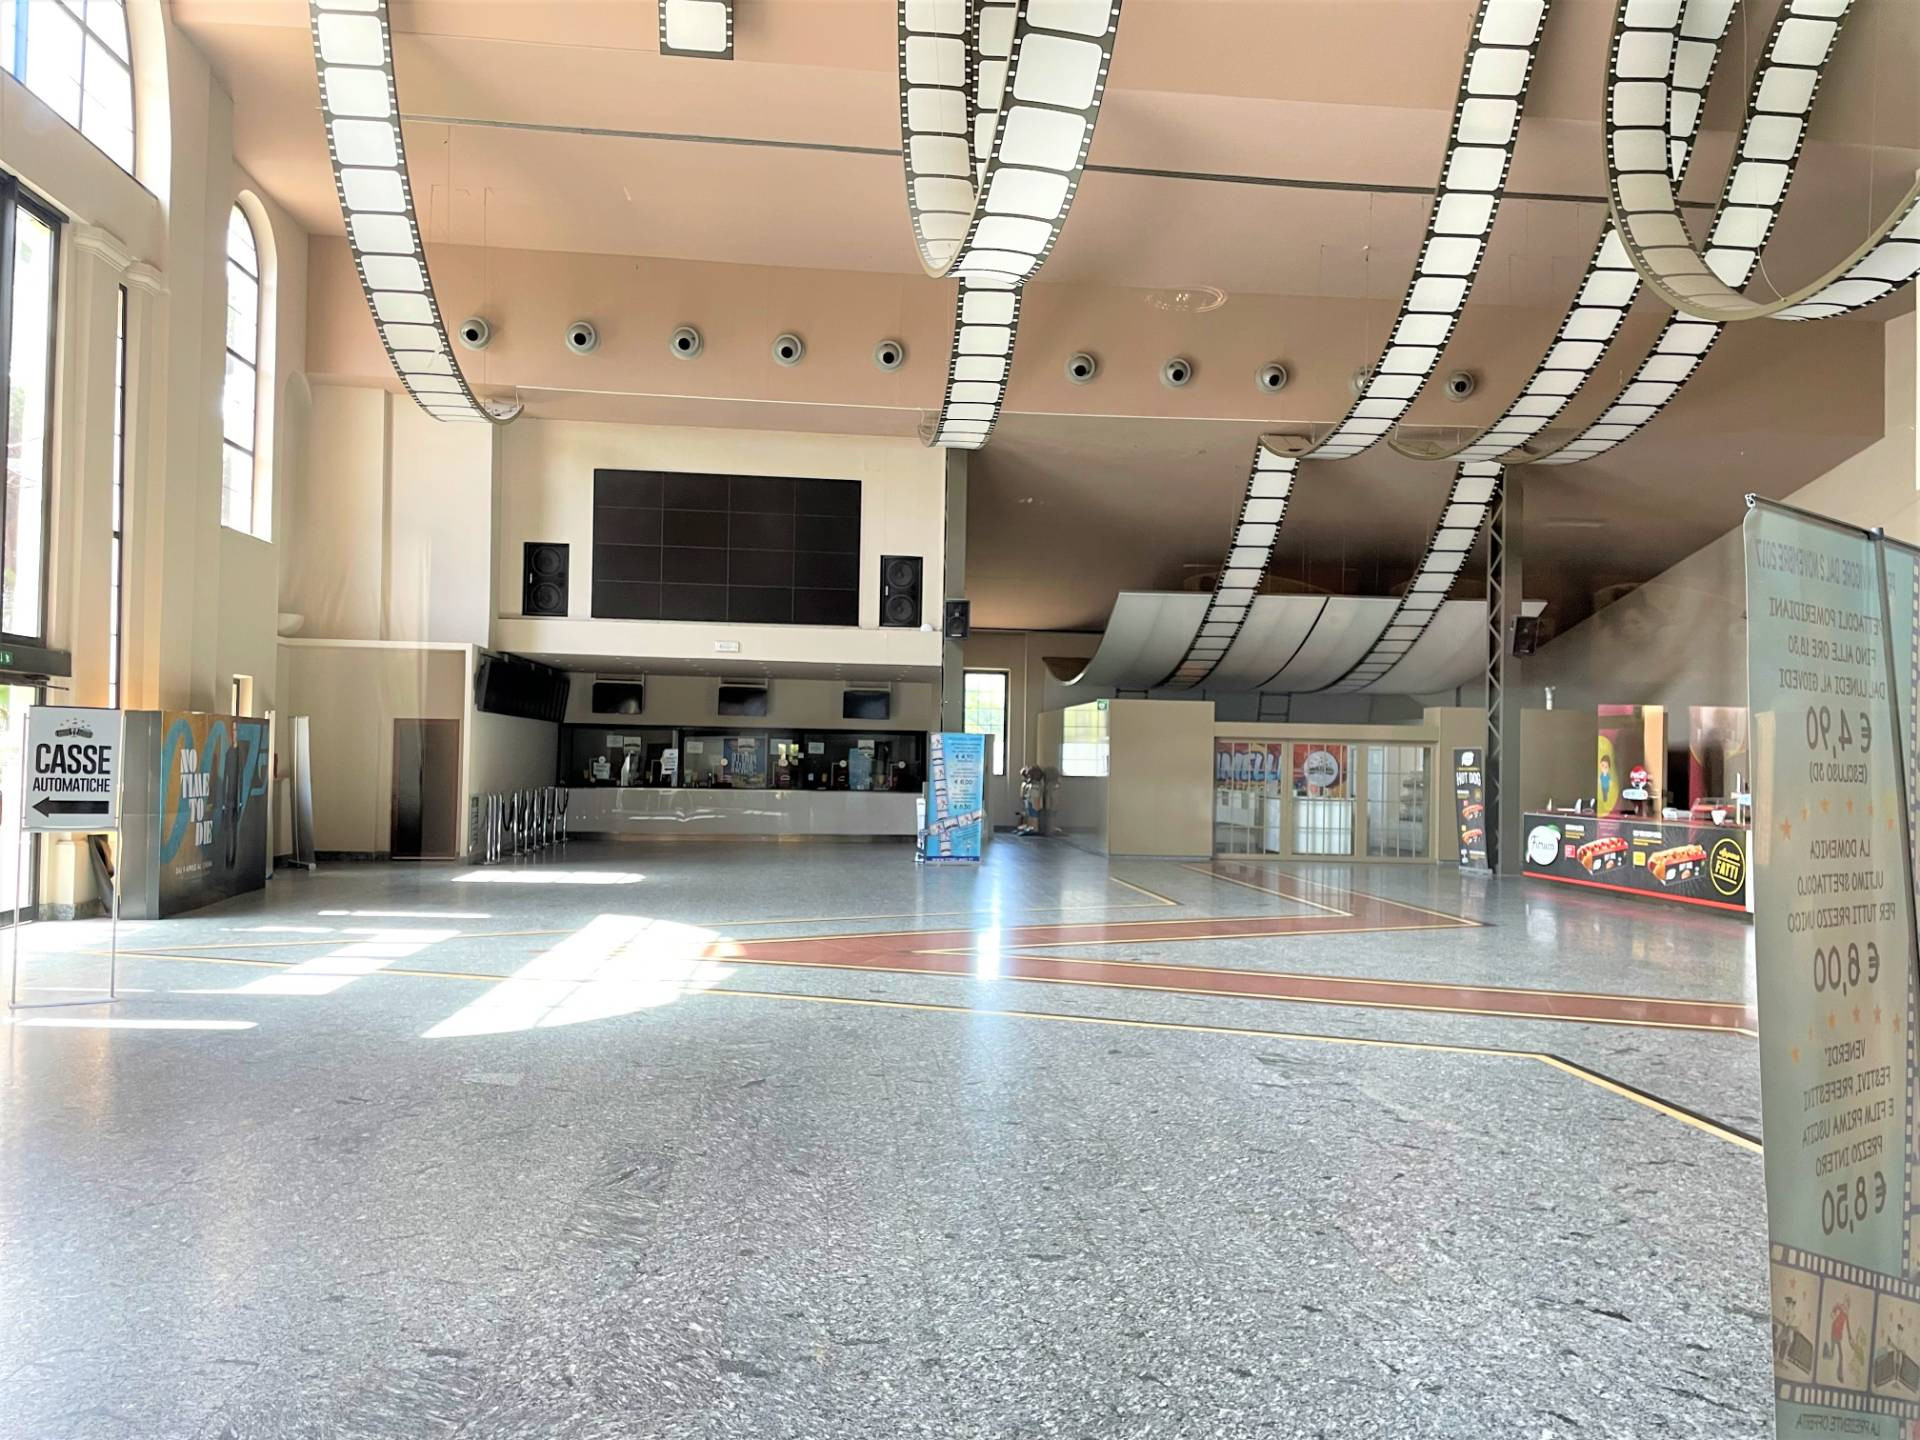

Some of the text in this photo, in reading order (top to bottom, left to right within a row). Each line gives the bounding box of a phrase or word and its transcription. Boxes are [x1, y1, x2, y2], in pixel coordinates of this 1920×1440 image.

[35, 743, 112, 775] CASSE
[180, 748, 198, 774] NO
[32, 777, 110, 792] AUTOMATICHE
[181, 772, 210, 799] TIME
[1456, 771, 1481, 786] HOT DOG
[189, 798, 205, 822] TO
[195, 820, 213, 847] DIE
[1714, 859, 1740, 881] FATTI
